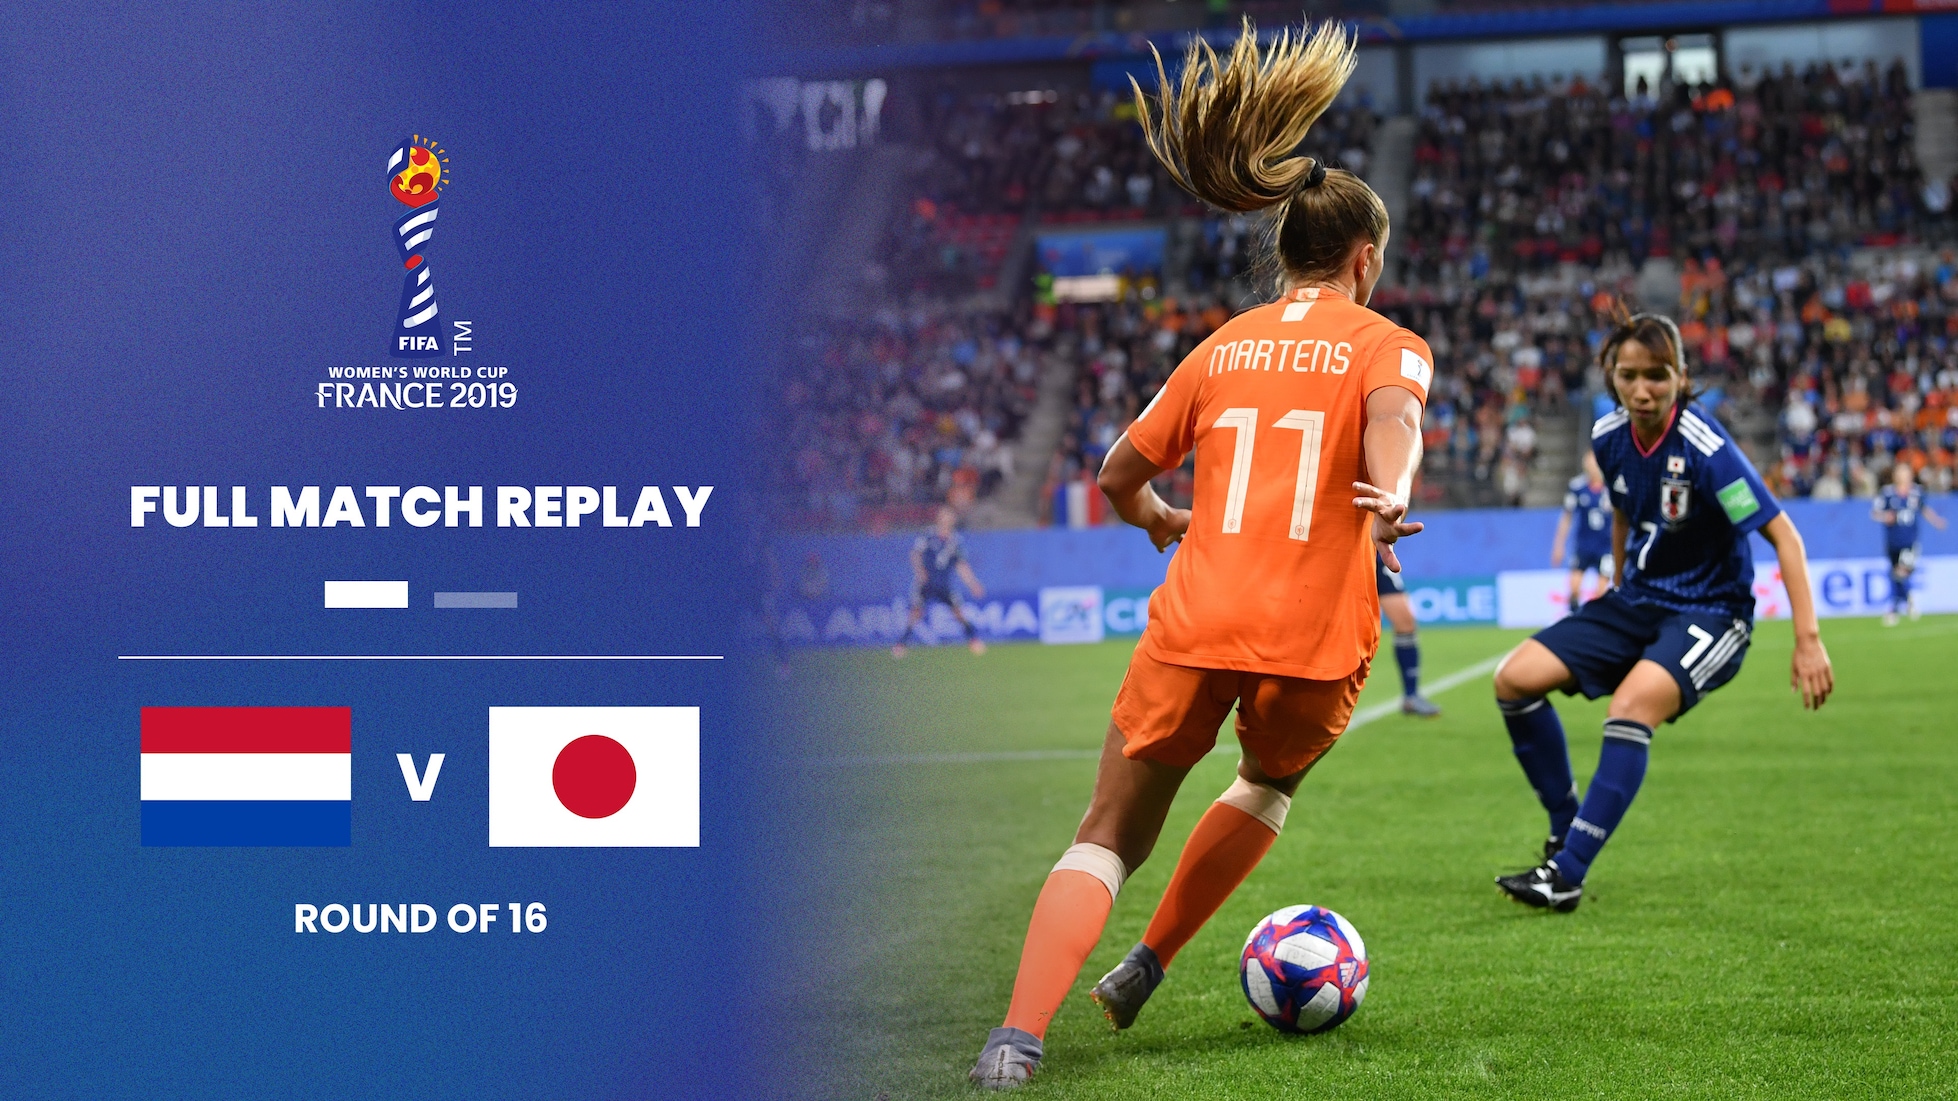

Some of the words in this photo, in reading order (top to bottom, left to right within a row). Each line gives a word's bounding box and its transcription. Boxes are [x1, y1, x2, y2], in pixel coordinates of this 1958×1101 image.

[1208, 339, 1353, 376] MARTENS
[1212, 407, 1325, 542] 11
[1638, 522, 1658, 570] 7
[1680, 624, 1714, 669] 7
